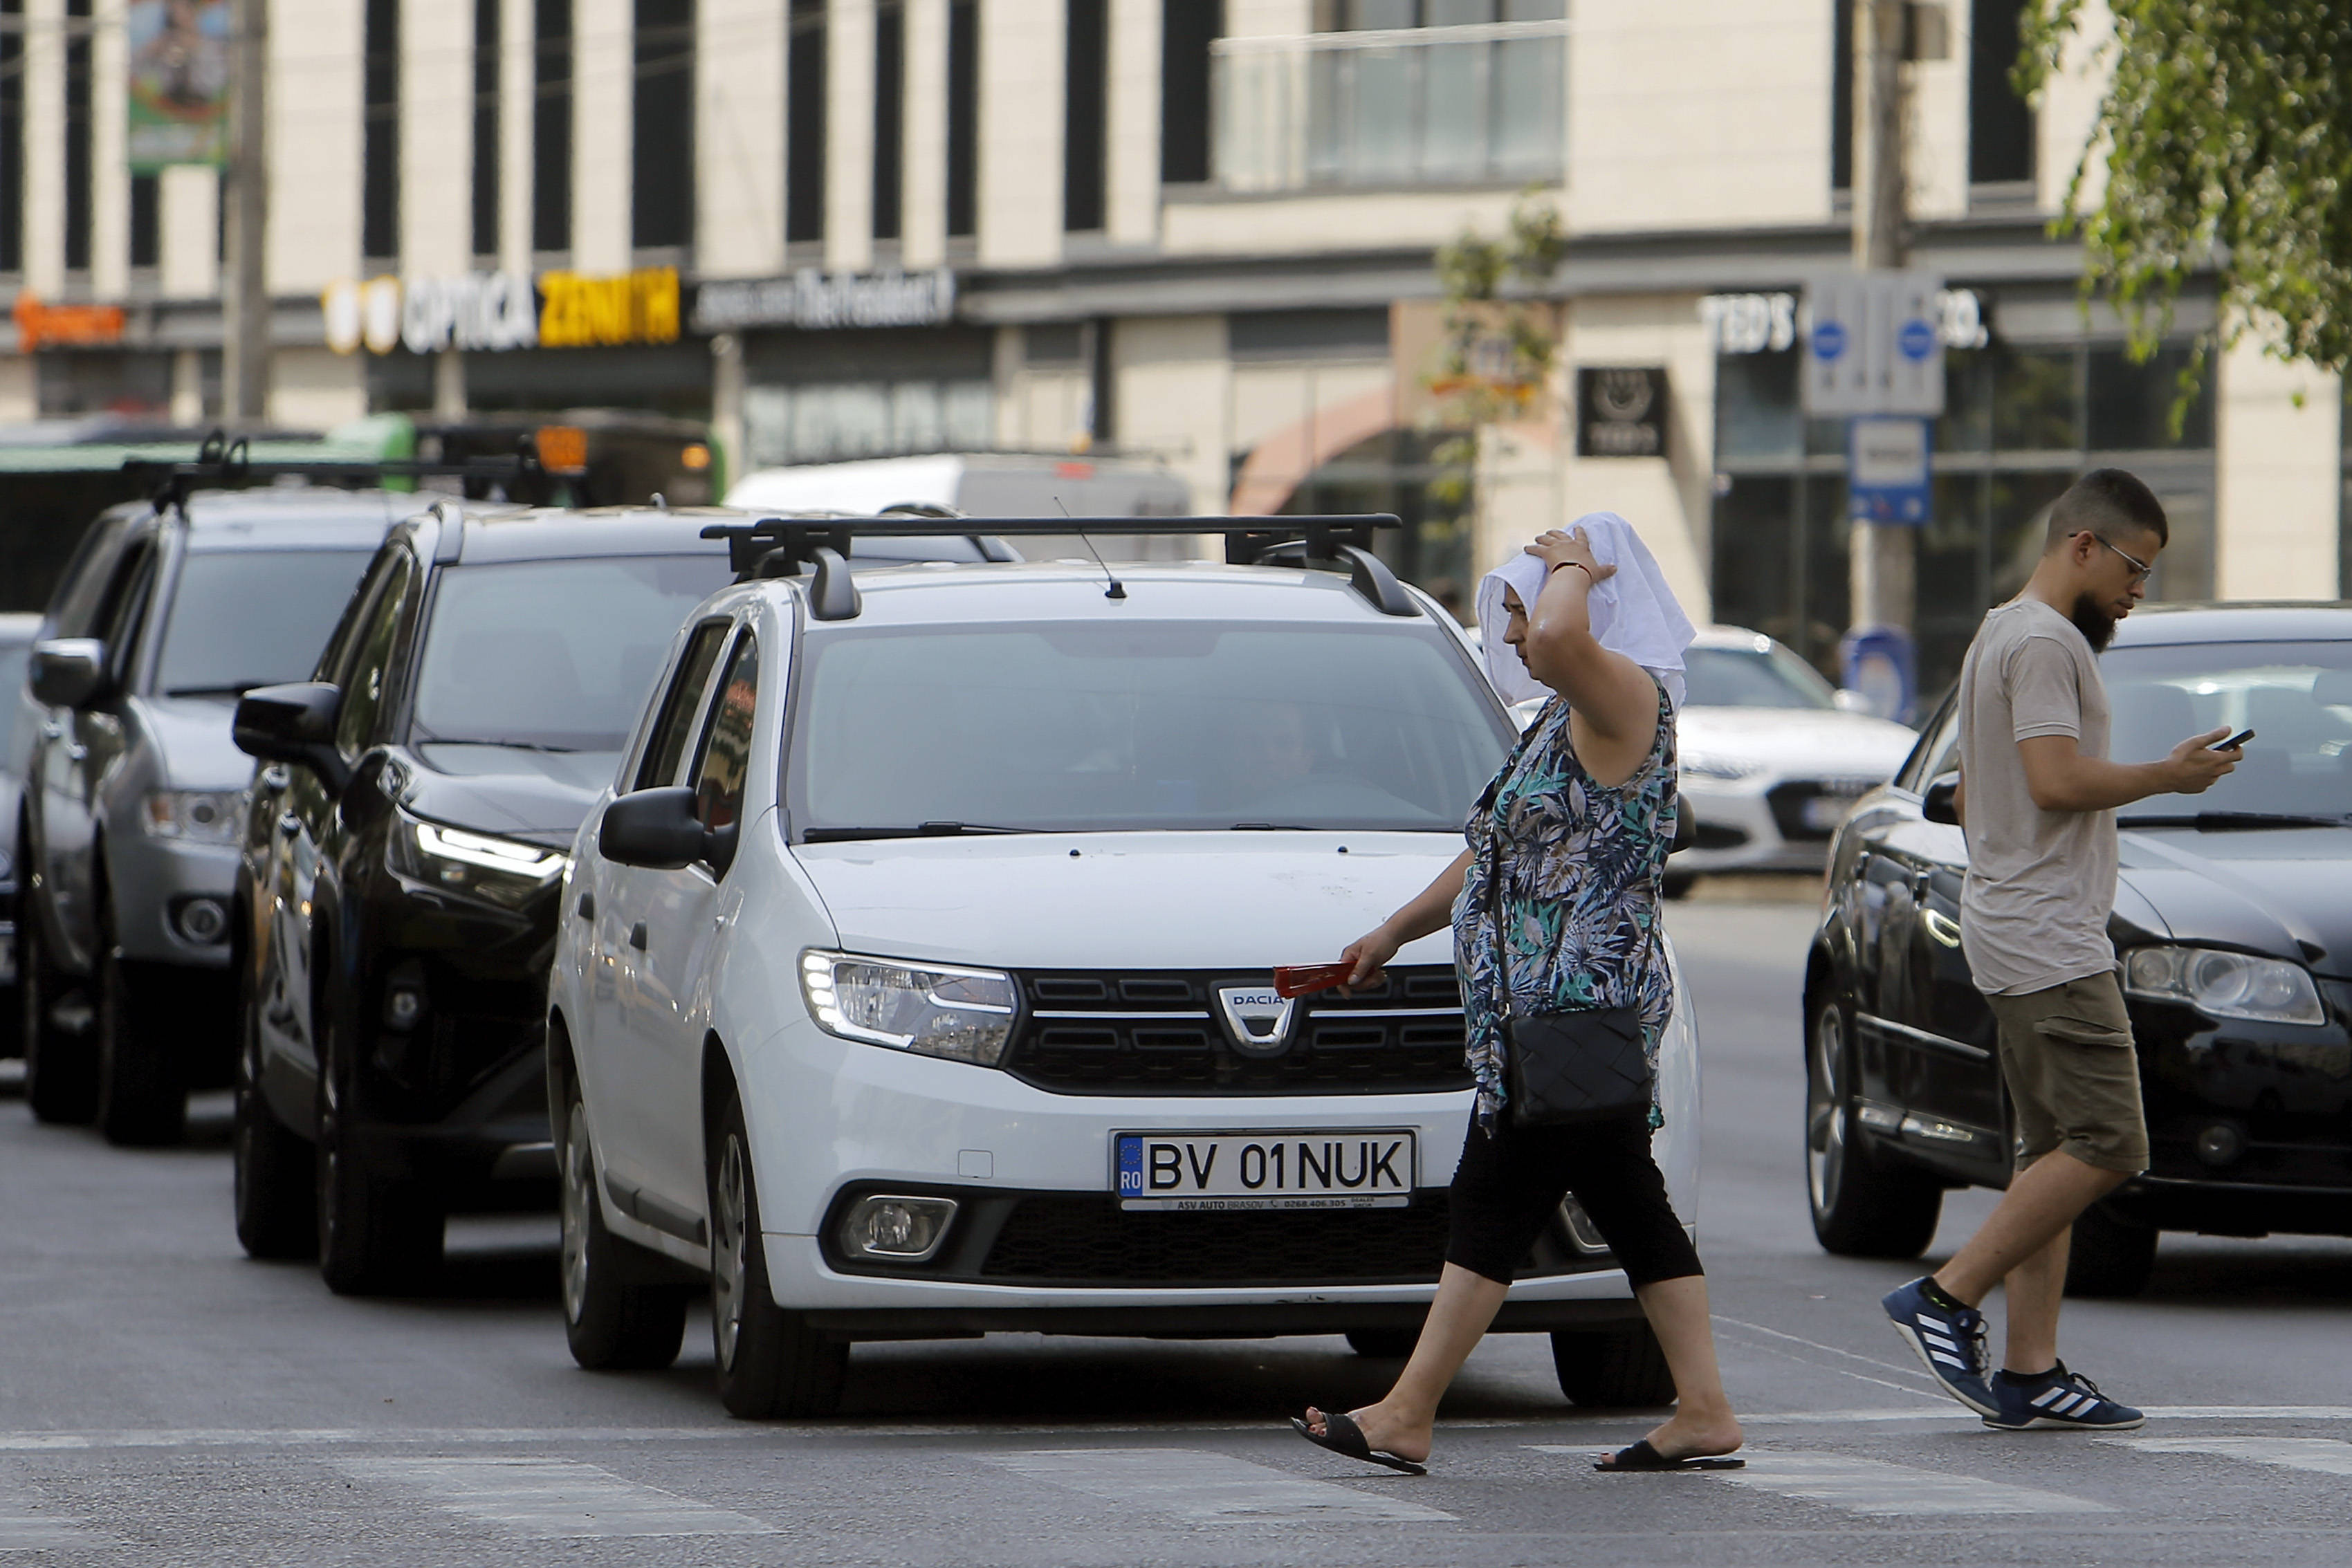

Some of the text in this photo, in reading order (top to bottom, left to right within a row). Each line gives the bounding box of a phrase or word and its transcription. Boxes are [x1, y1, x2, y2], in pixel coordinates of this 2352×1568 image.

[401, 273, 538, 353] OPTICA
[538, 266, 681, 347] ZENITH
[1233, 996, 1284, 1005] DACIA
[1149, 1143, 1218, 1189] BV
[1121, 1171, 1141, 1189] RO
[1177, 1201, 1197, 1209] ASV
[1200, 1201, 1225, 1209] AUTO
